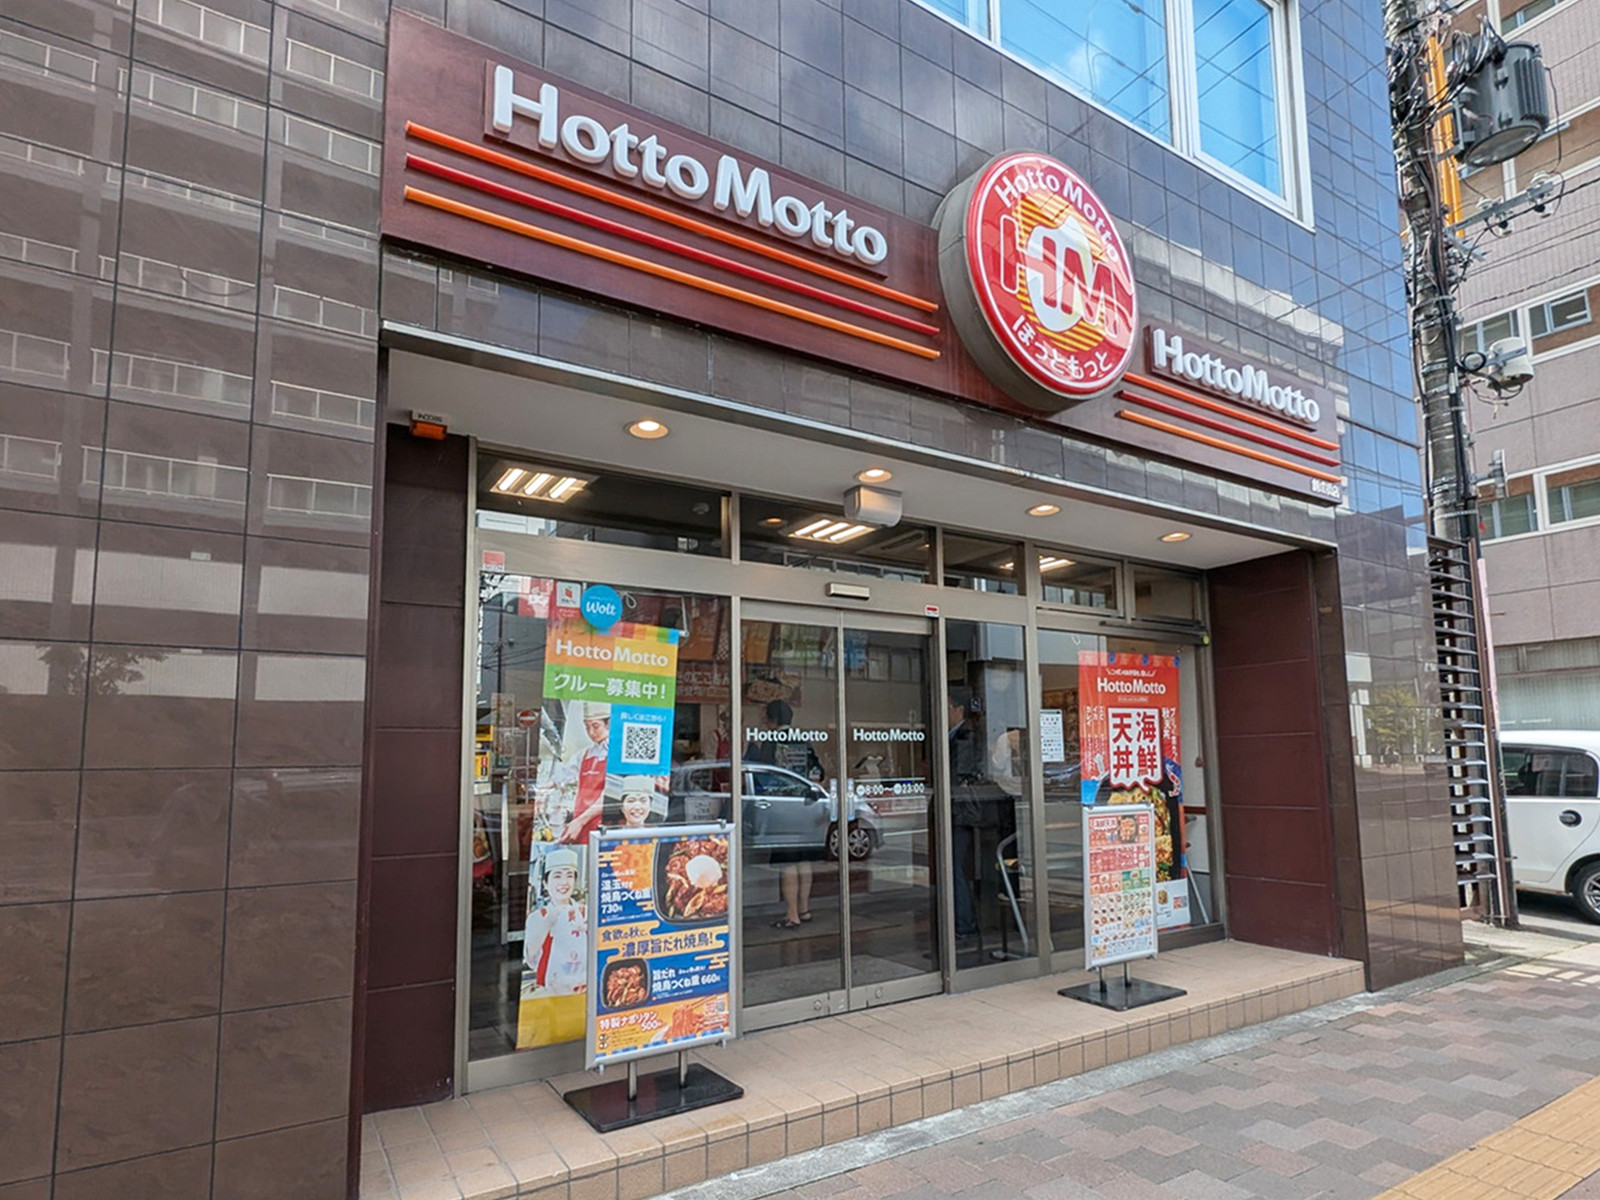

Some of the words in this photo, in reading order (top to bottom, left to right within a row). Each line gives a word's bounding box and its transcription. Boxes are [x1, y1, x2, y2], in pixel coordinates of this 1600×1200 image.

[1012, 315, 1113, 380] ほっともっと
[586, 601, 616, 616] Wolt
[554, 673, 667, 699] クルー募集中!
[1111, 712, 1134, 779] 天丼
[1136, 711, 1158, 777] 海鮮
